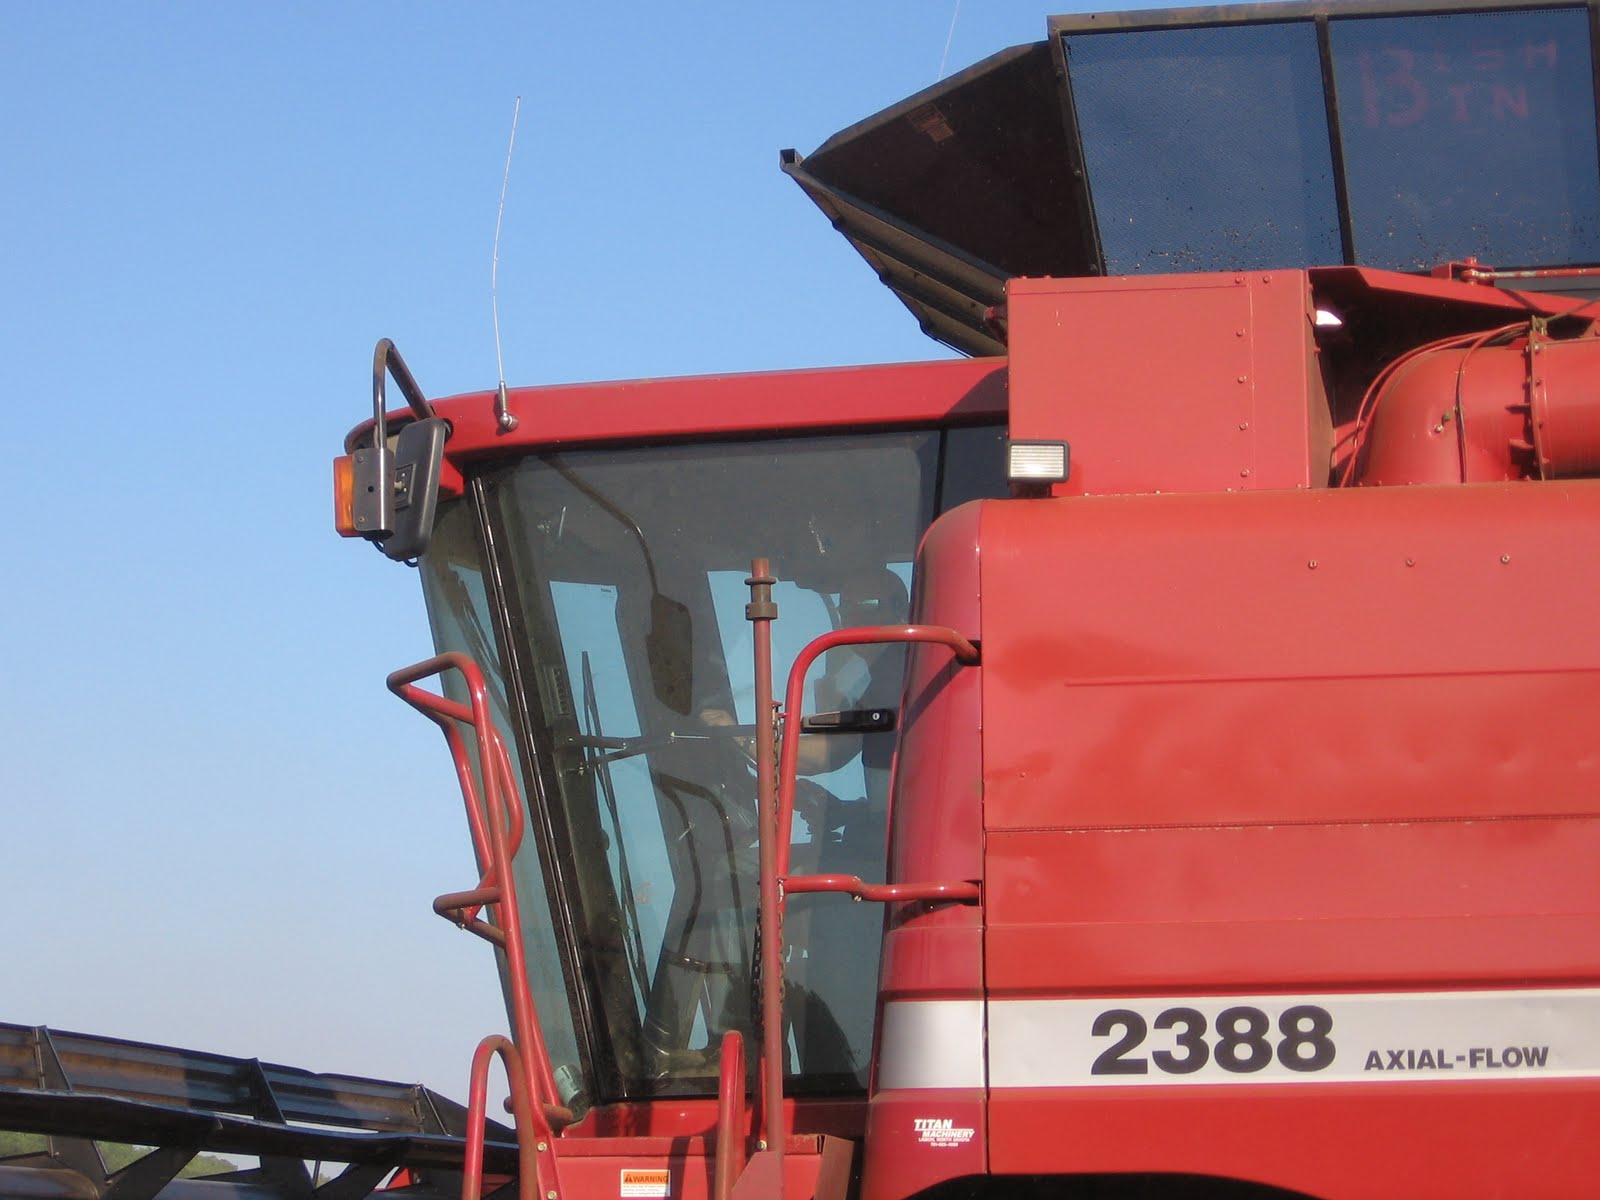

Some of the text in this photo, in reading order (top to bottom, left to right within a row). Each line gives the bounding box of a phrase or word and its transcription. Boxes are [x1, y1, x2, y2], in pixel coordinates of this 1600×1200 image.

[1090, 1005, 1336, 1075] 2388
[1364, 1046, 1549, 1071] AXIAL-FLOW
[914, 1119, 953, 1129] TITAN
[922, 1130, 975, 1138] MACHINERY
[633, 1175, 669, 1183] WARNING
